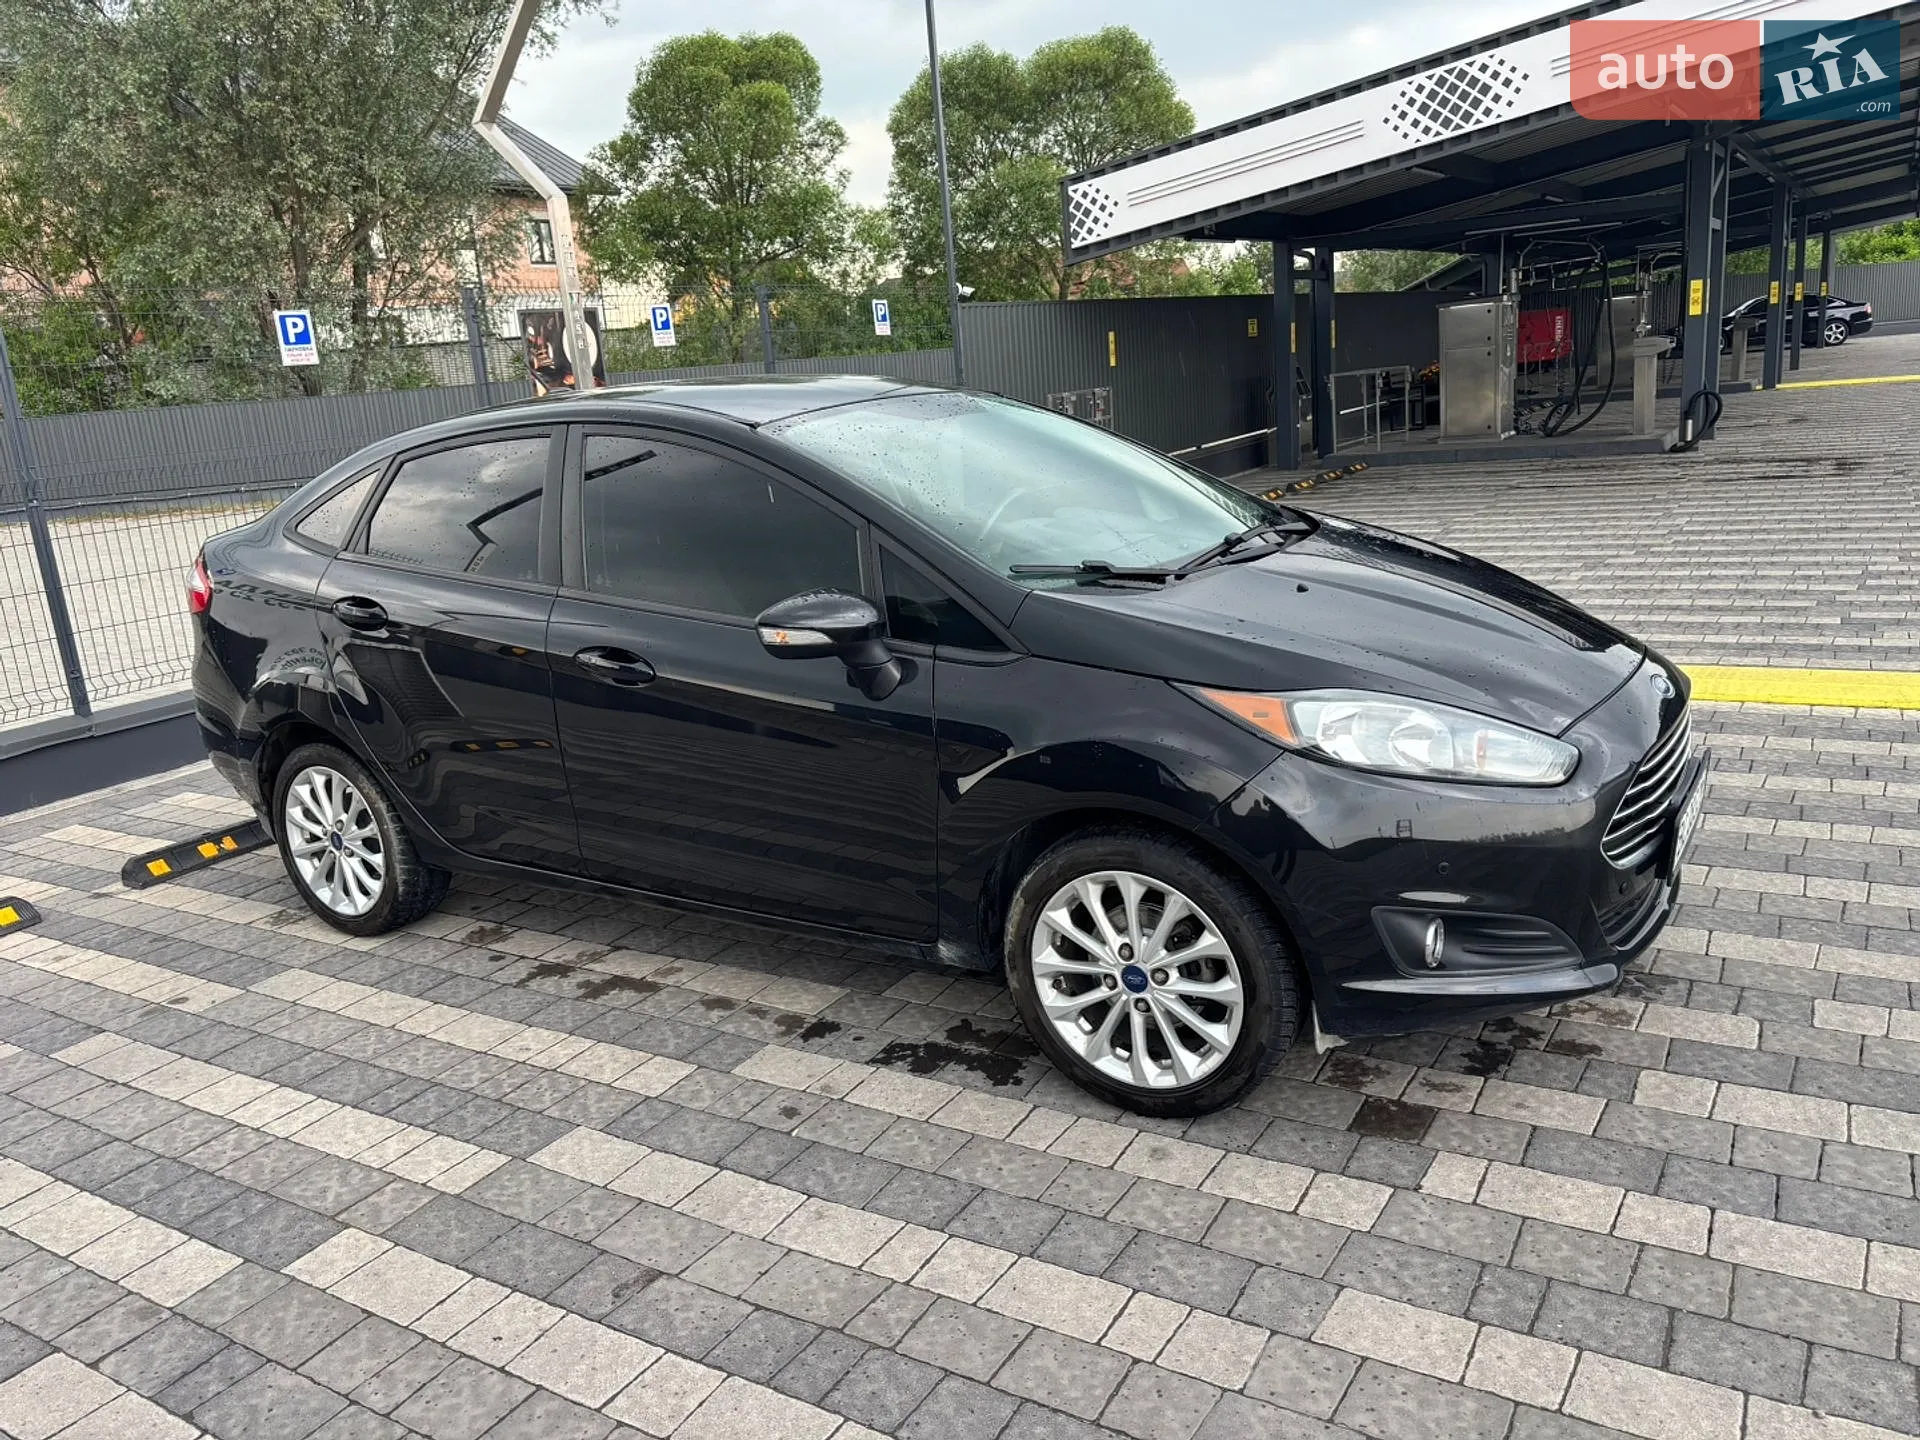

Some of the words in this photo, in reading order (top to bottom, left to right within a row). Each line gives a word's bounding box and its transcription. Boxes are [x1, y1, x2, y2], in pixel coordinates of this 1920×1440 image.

[655, 309, 667, 329] P
[877, 304, 886, 321] P
[285, 317, 304, 343] P
